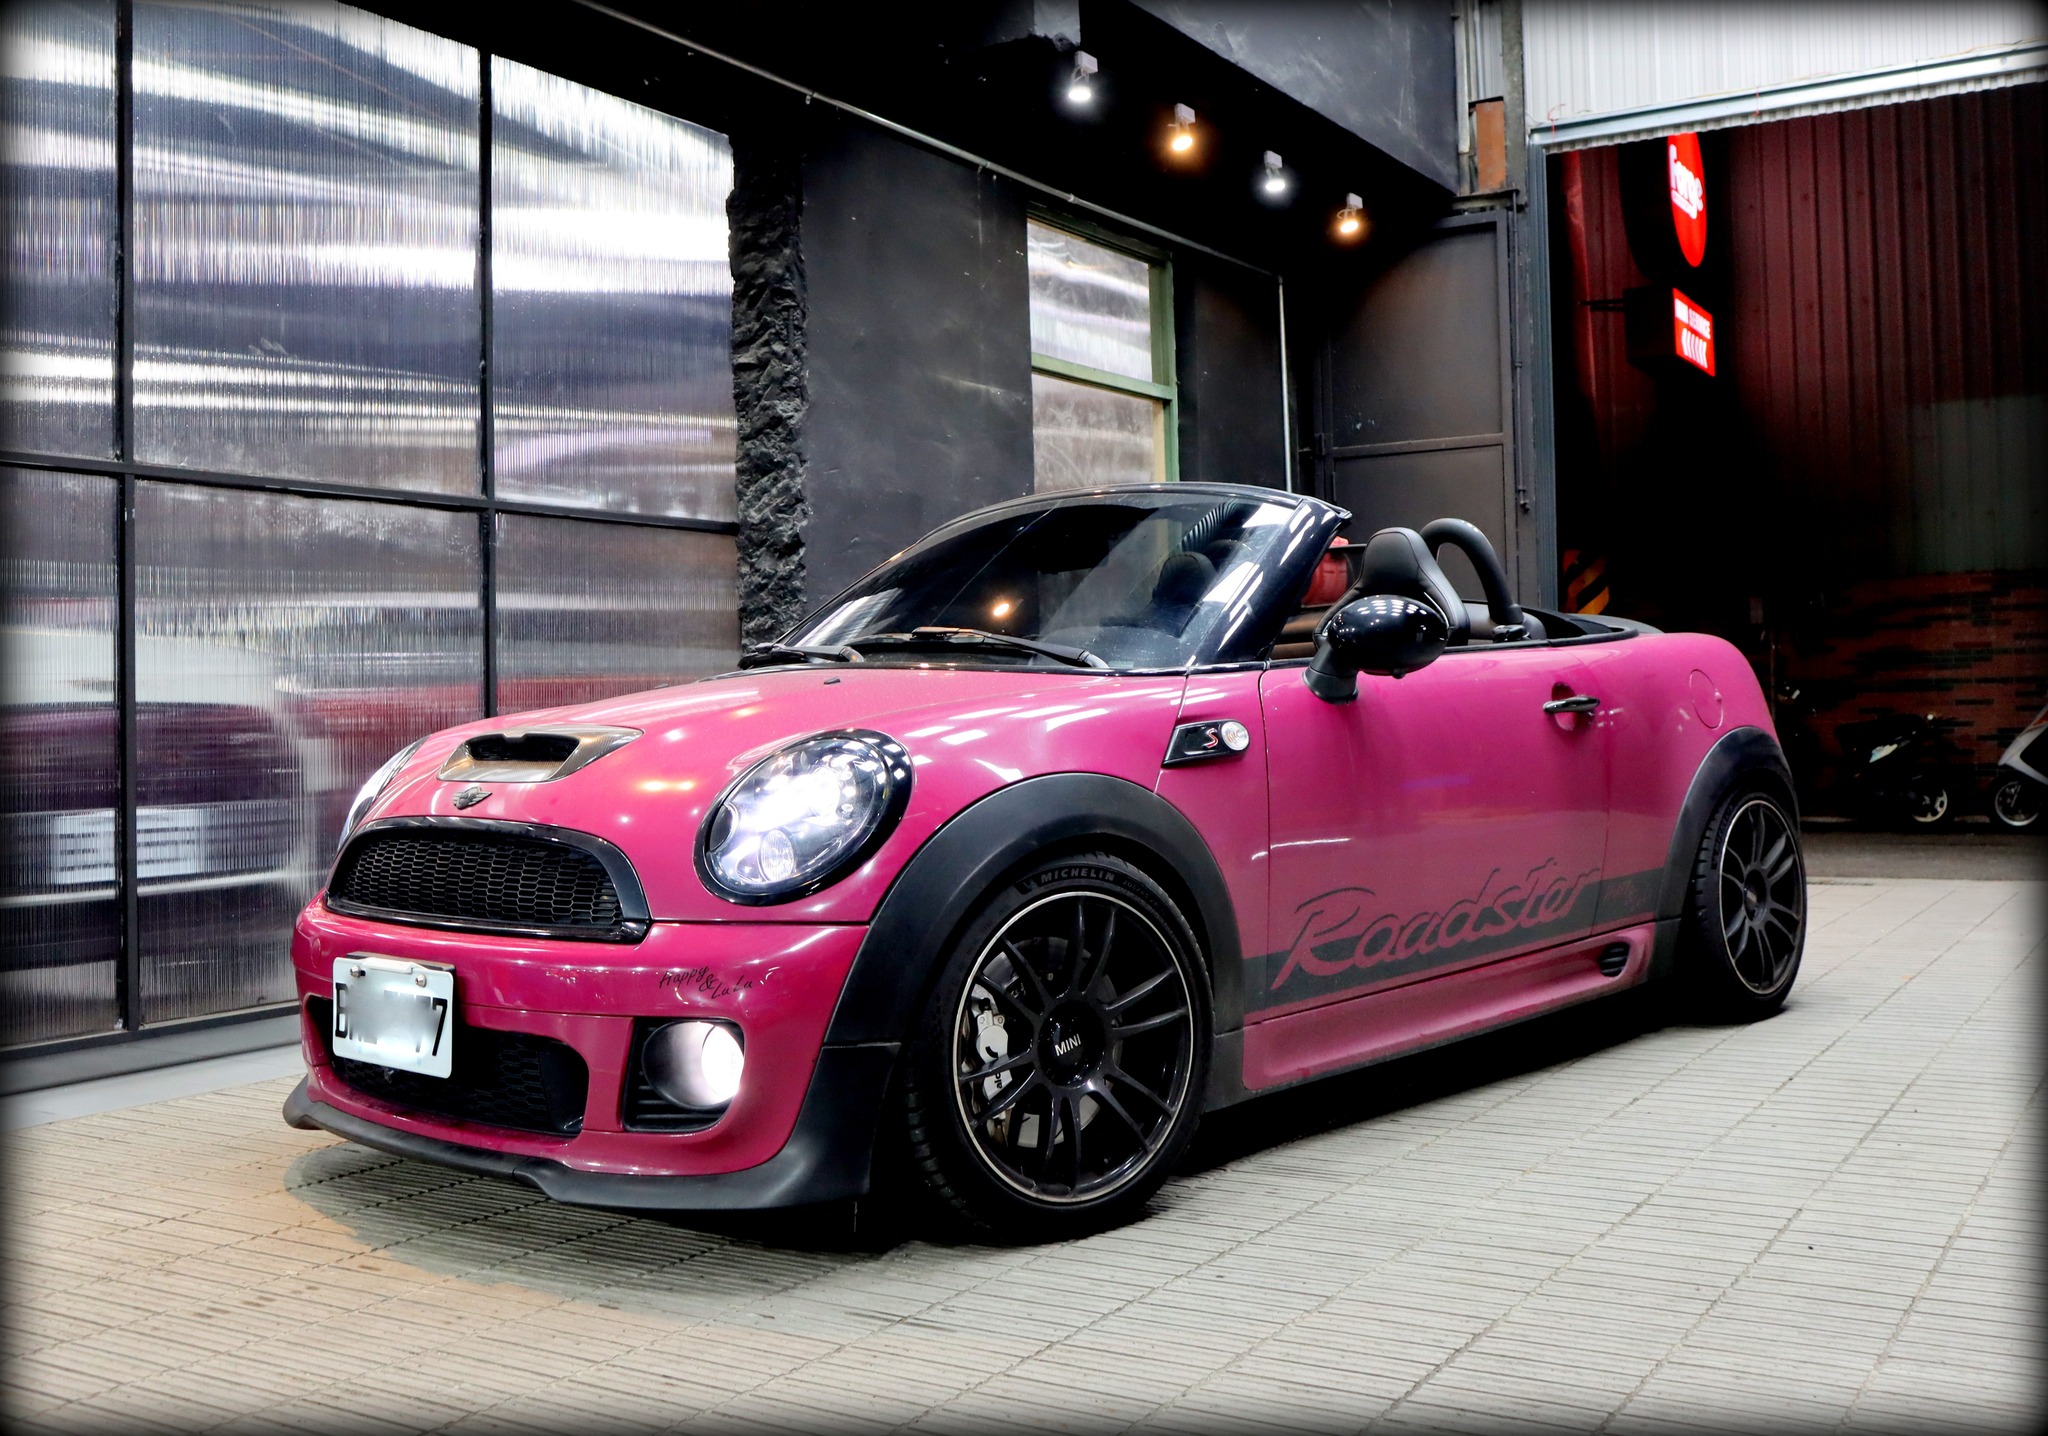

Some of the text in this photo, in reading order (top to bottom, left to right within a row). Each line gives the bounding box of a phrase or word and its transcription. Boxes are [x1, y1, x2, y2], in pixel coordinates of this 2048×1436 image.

[1202, 728, 1219, 749] S
[1040, 868, 1115, 884] MICHELIN
[1271, 857, 1601, 990] Roadster
[660, 966, 709, 989] Happy
[1055, 1033, 1081, 1057] MINI
